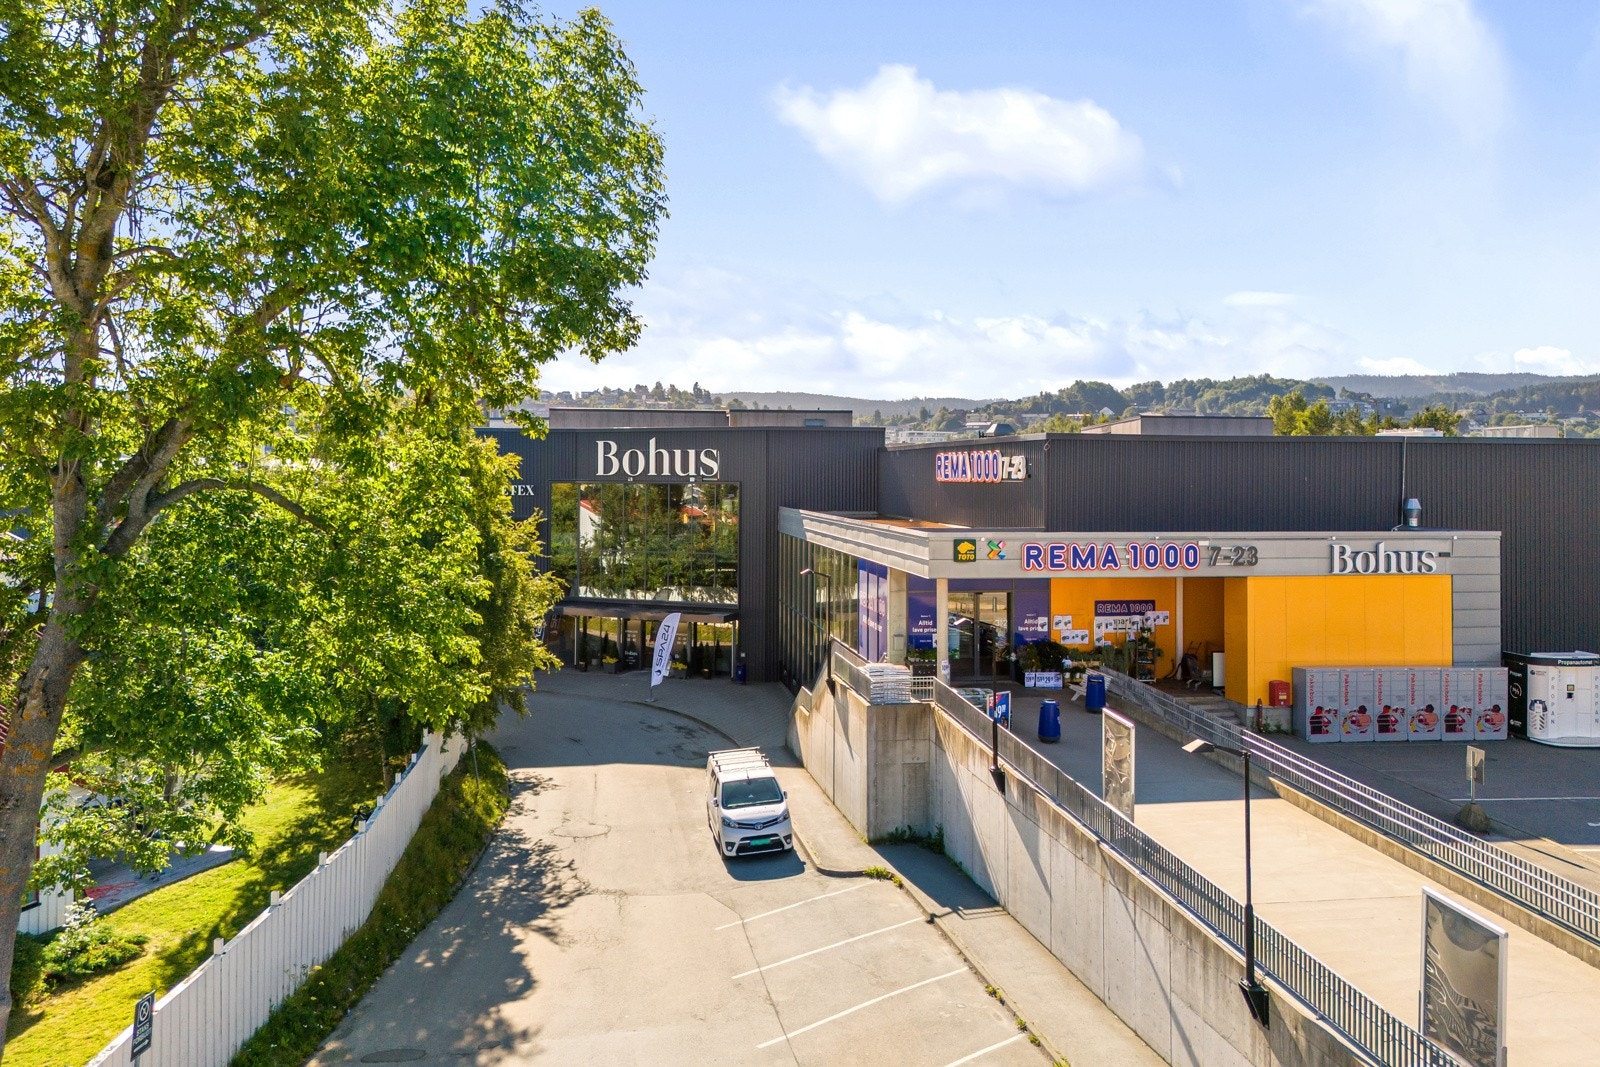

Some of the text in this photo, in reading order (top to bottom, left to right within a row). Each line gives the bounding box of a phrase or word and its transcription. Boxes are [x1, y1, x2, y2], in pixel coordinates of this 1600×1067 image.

[596, 437, 719, 477] Bohus
[936, 450, 1026, 483] REMA 1000 7-23
[1022, 542, 1259, 571] REMA 1000 7-23
[1330, 541, 1437, 574] Bohus
[1097, 603, 1153, 613] REMA 1000
